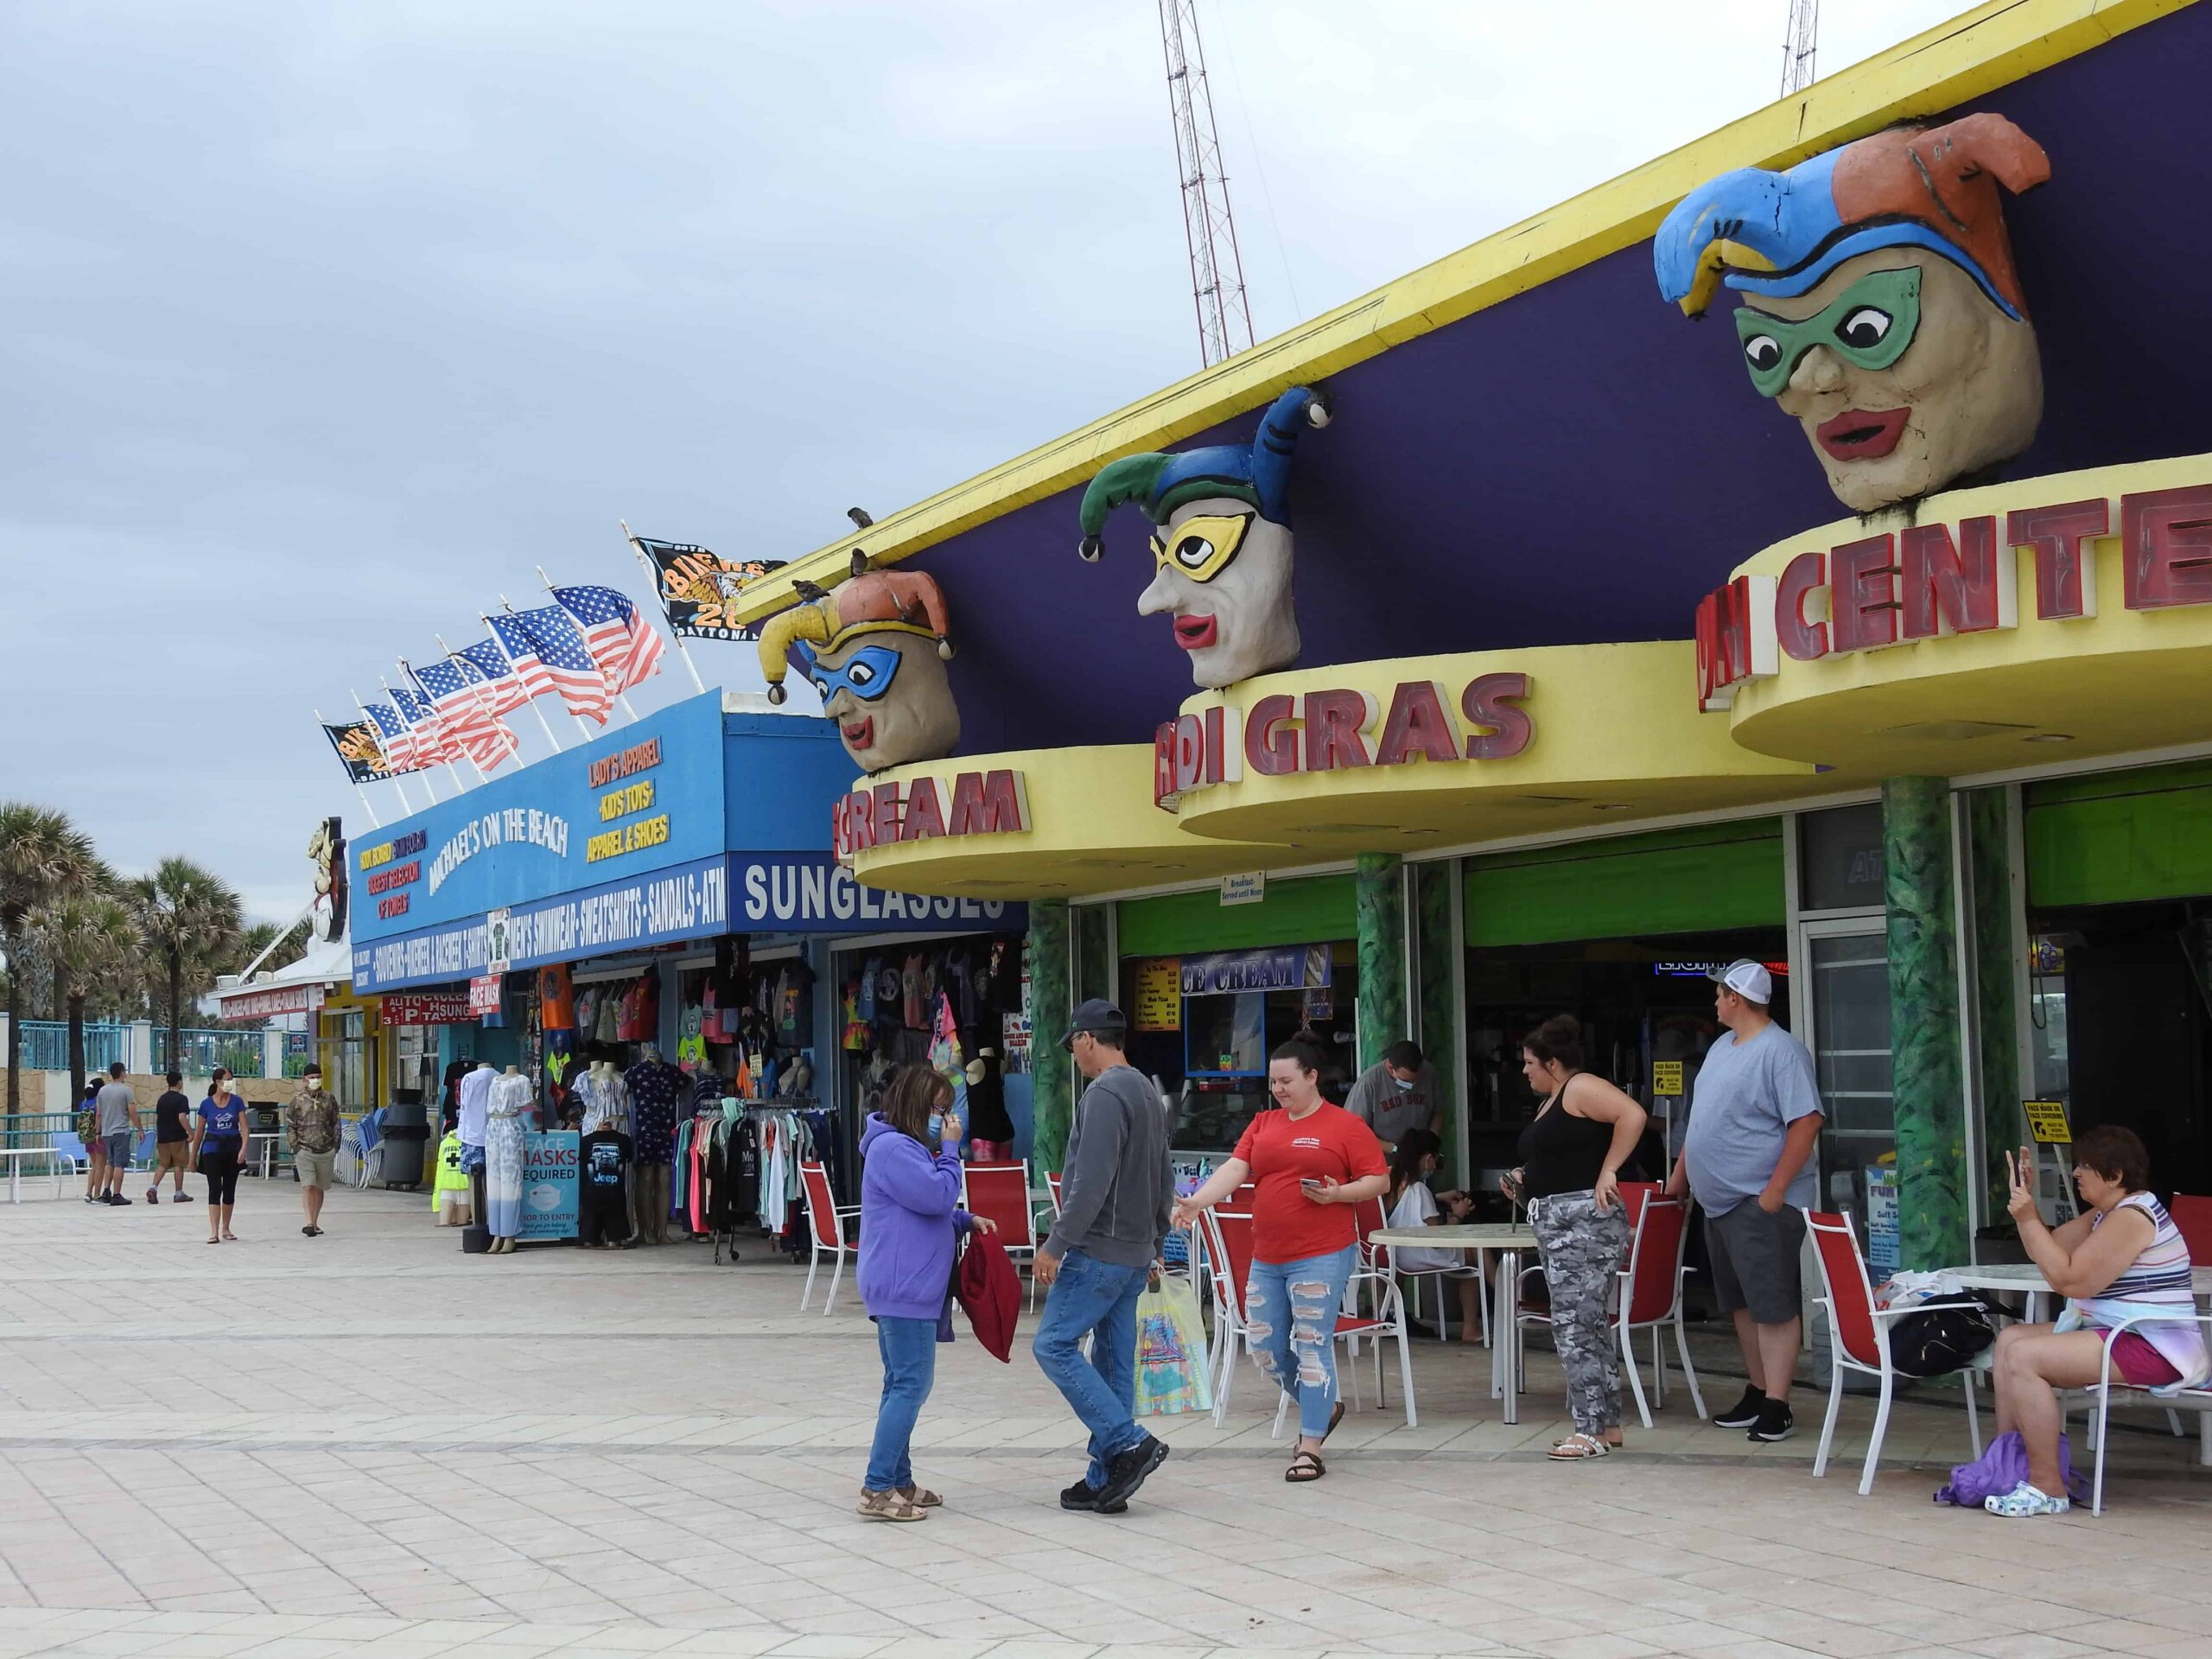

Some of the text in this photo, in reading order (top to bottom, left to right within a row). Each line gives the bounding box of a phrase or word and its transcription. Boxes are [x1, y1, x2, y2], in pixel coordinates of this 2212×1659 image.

[1776, 484, 2212, 661] CENTE
[677, 626, 747, 640] DAYTONA
[1245, 672, 1534, 776] GRAS
[588, 738, 661, 788] LADY'S APPAREL
[601, 780, 651, 822] KID'S TOYS
[838, 769, 1027, 855] CREAM
[429, 808, 569, 896] MICHAEL'S ON THE BEACH
[587, 812, 670, 863] APPAREL & SHOES
[534, 903, 575, 957] SWIMWEAR
[580, 887, 641, 947] SWEATSHIRTS
[649, 874, 695, 935] SANDALS
[702, 867, 725, 925] ATM
[470, 983, 500, 1008] FACE MASK
[1213, 955, 1295, 992] CREAM
[524, 1137, 565, 1150] FACE
[524, 1168, 575, 1182] EQUIRED
[594, 1173, 618, 1184] Jeep
